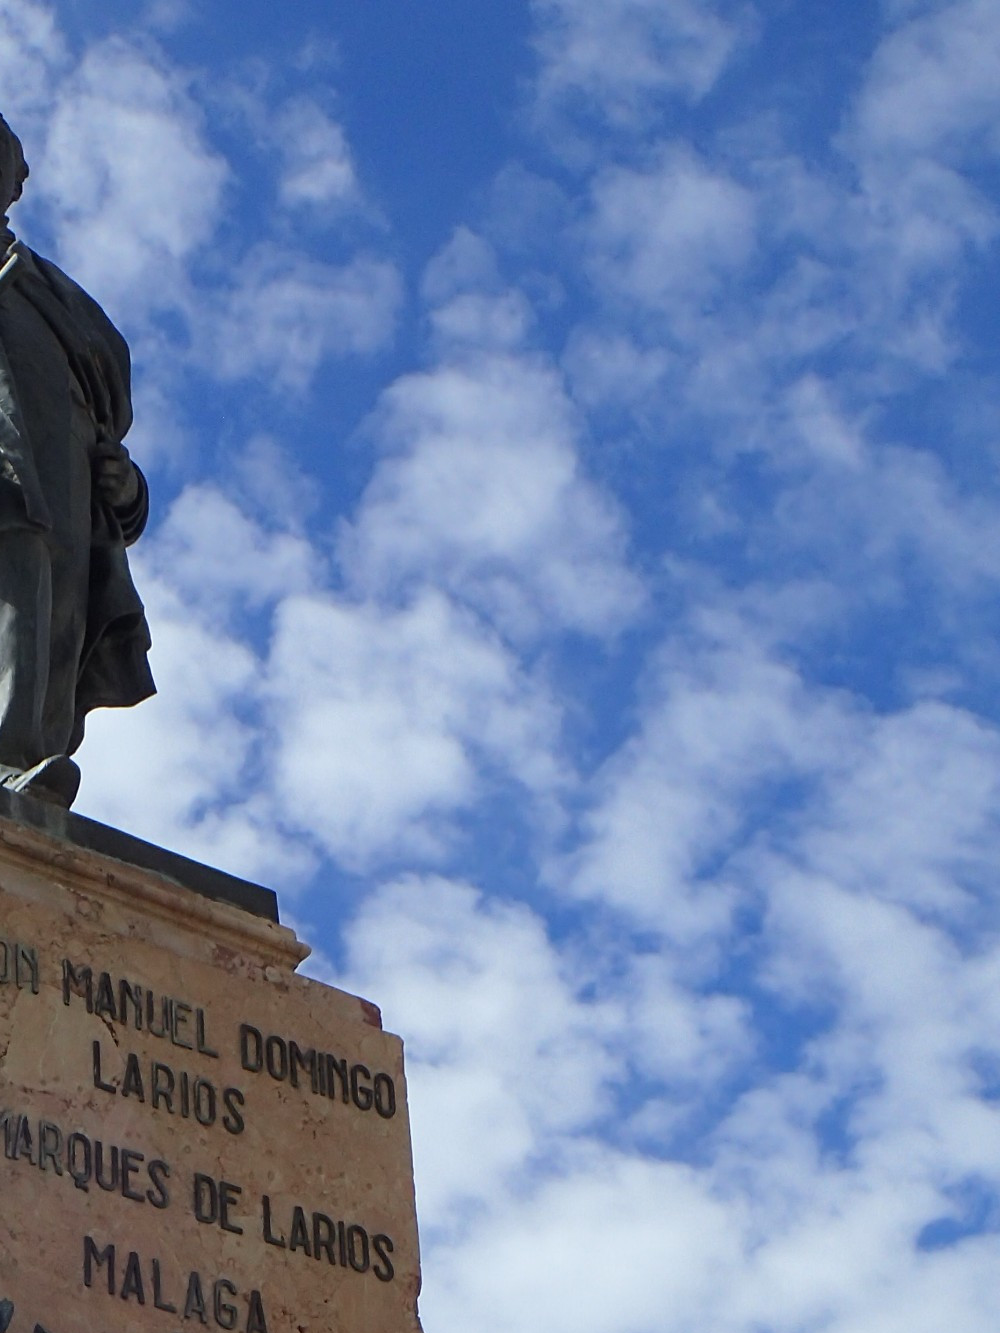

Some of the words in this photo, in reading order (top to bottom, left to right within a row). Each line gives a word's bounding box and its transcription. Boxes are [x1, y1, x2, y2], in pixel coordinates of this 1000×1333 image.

[61, 959, 218, 1058] MANUEL
[240, 1023, 397, 1119] DOMINGO
[93, 1040, 245, 1134] LARIOS
[194, 1173, 243, 1234] DE
[263, 1195, 395, 1282] LARIOS
